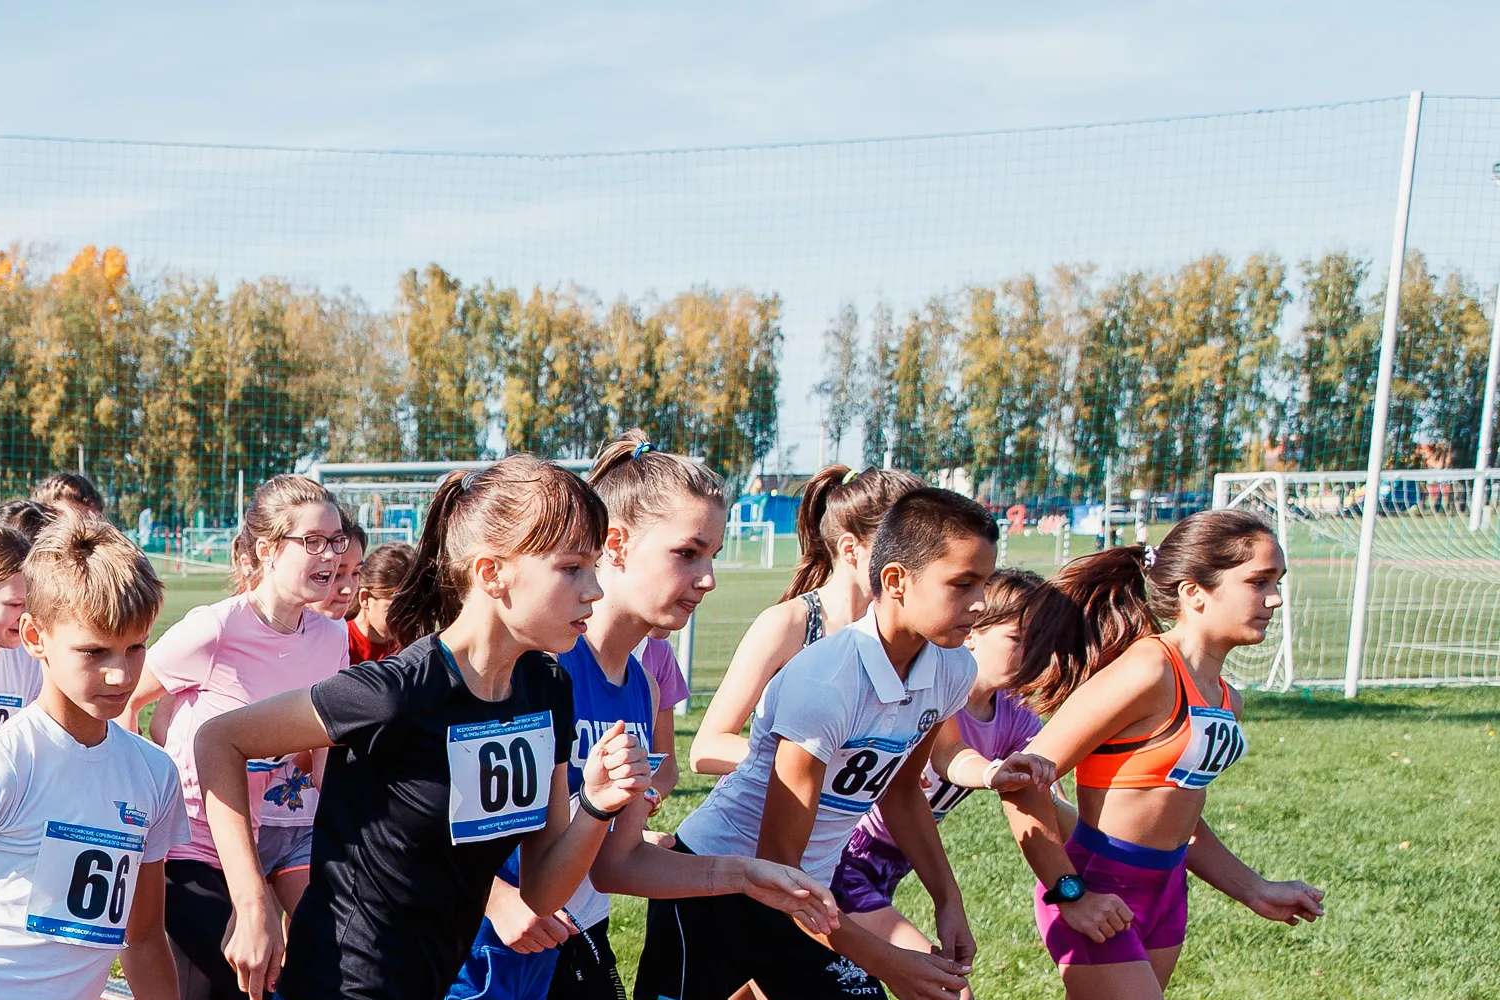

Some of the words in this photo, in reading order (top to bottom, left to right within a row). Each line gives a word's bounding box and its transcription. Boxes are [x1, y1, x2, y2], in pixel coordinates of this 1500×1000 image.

[479, 737, 537, 813] 60
[831, 750, 903, 799] 84
[1197, 722, 1245, 773] 120
[66, 849, 130, 924] 66
